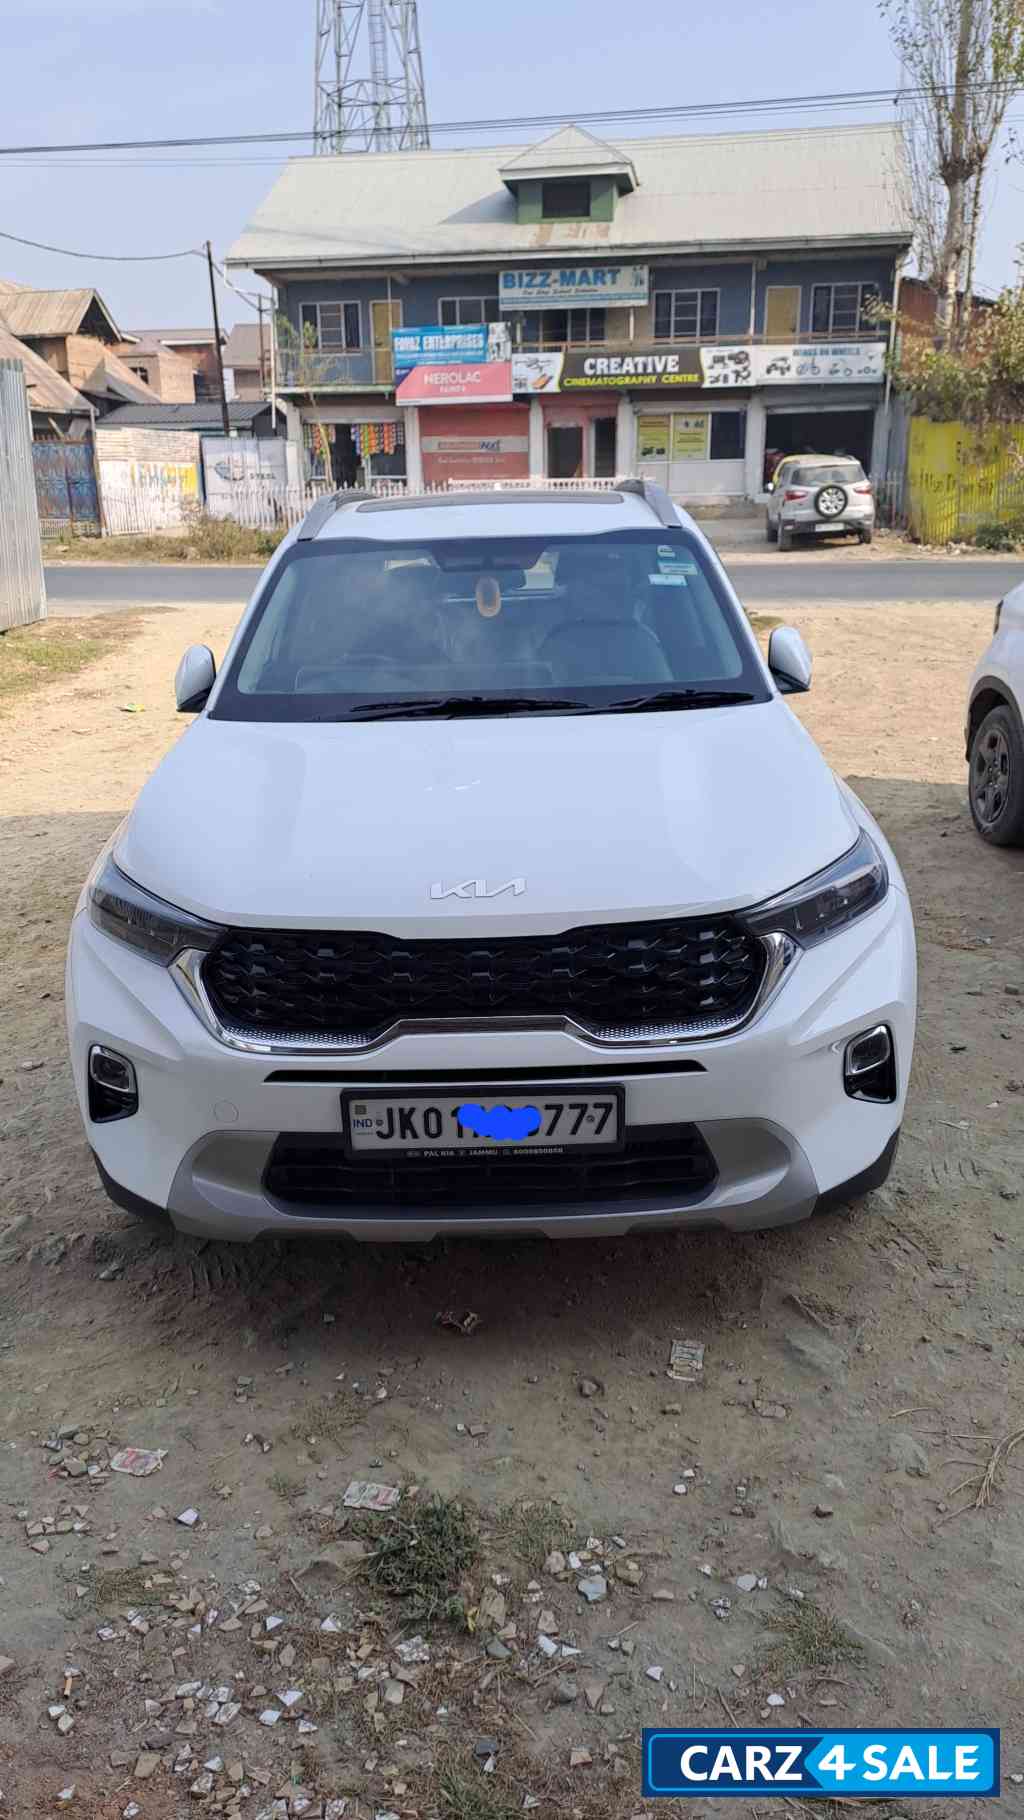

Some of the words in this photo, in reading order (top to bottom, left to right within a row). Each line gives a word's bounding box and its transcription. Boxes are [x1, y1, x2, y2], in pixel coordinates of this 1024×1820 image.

[503, 268, 621, 288] BIZZ-MART
[583, 355, 680, 375] CREATIVE
[424, 371, 481, 385] NEROLAC
[564, 375, 657, 387] CINEMATOGRAPHY
[353, 1119, 373, 1128] IND
